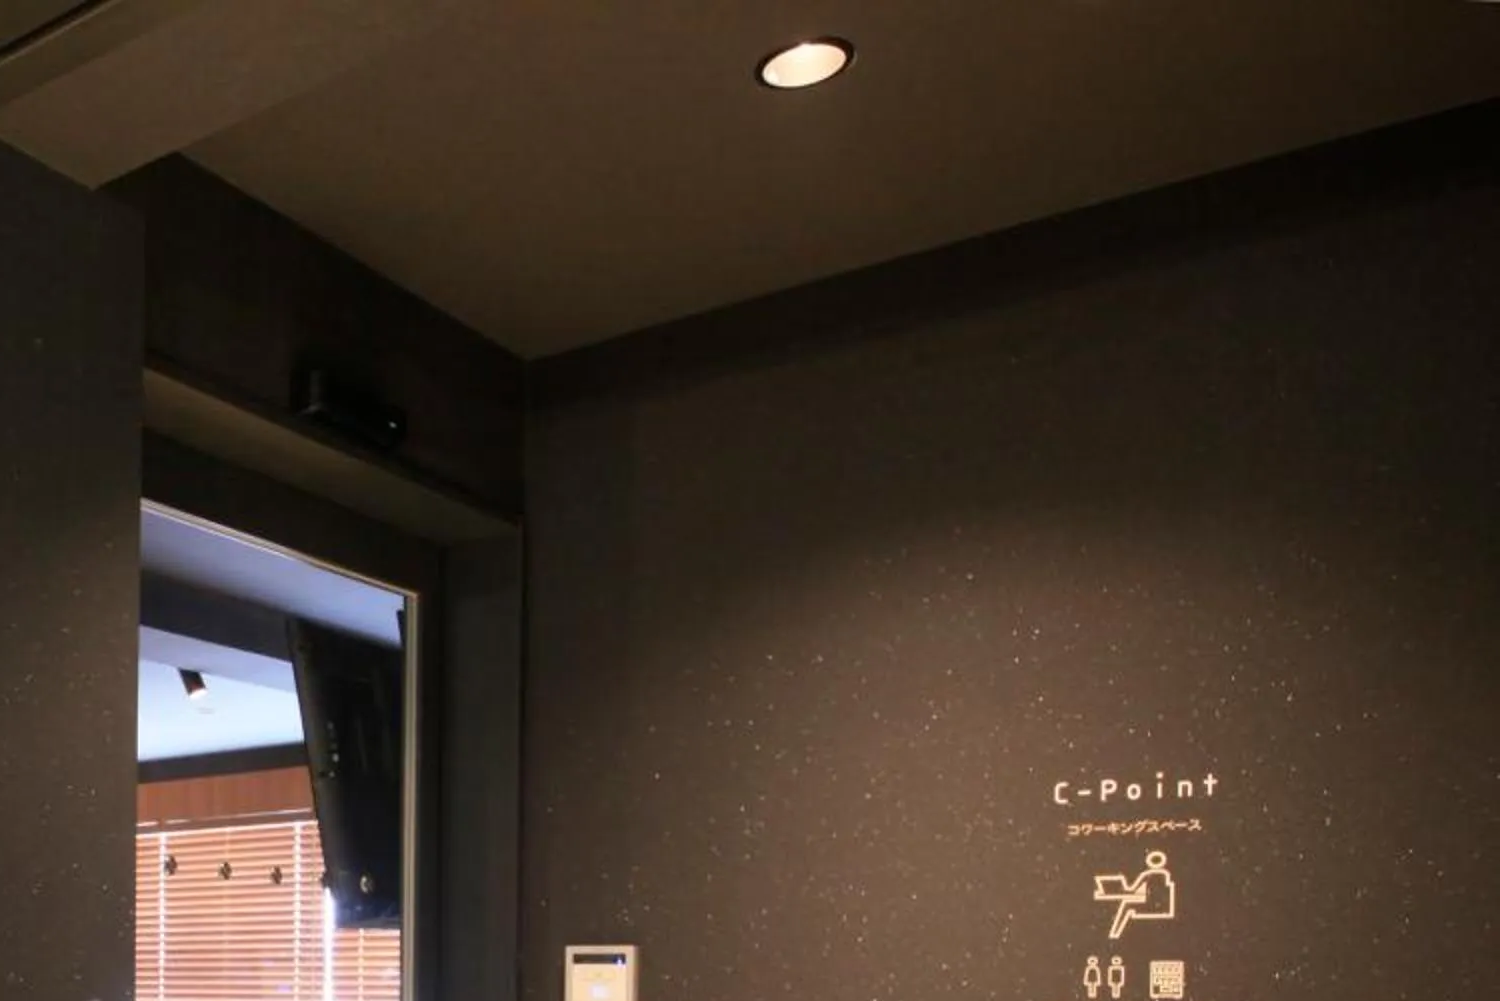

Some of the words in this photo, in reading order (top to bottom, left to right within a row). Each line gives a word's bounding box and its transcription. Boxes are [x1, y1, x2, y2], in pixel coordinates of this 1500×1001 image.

[1053, 771, 1219, 805] C-Point
[1067, 818, 1203, 838] コワーキングスペース
